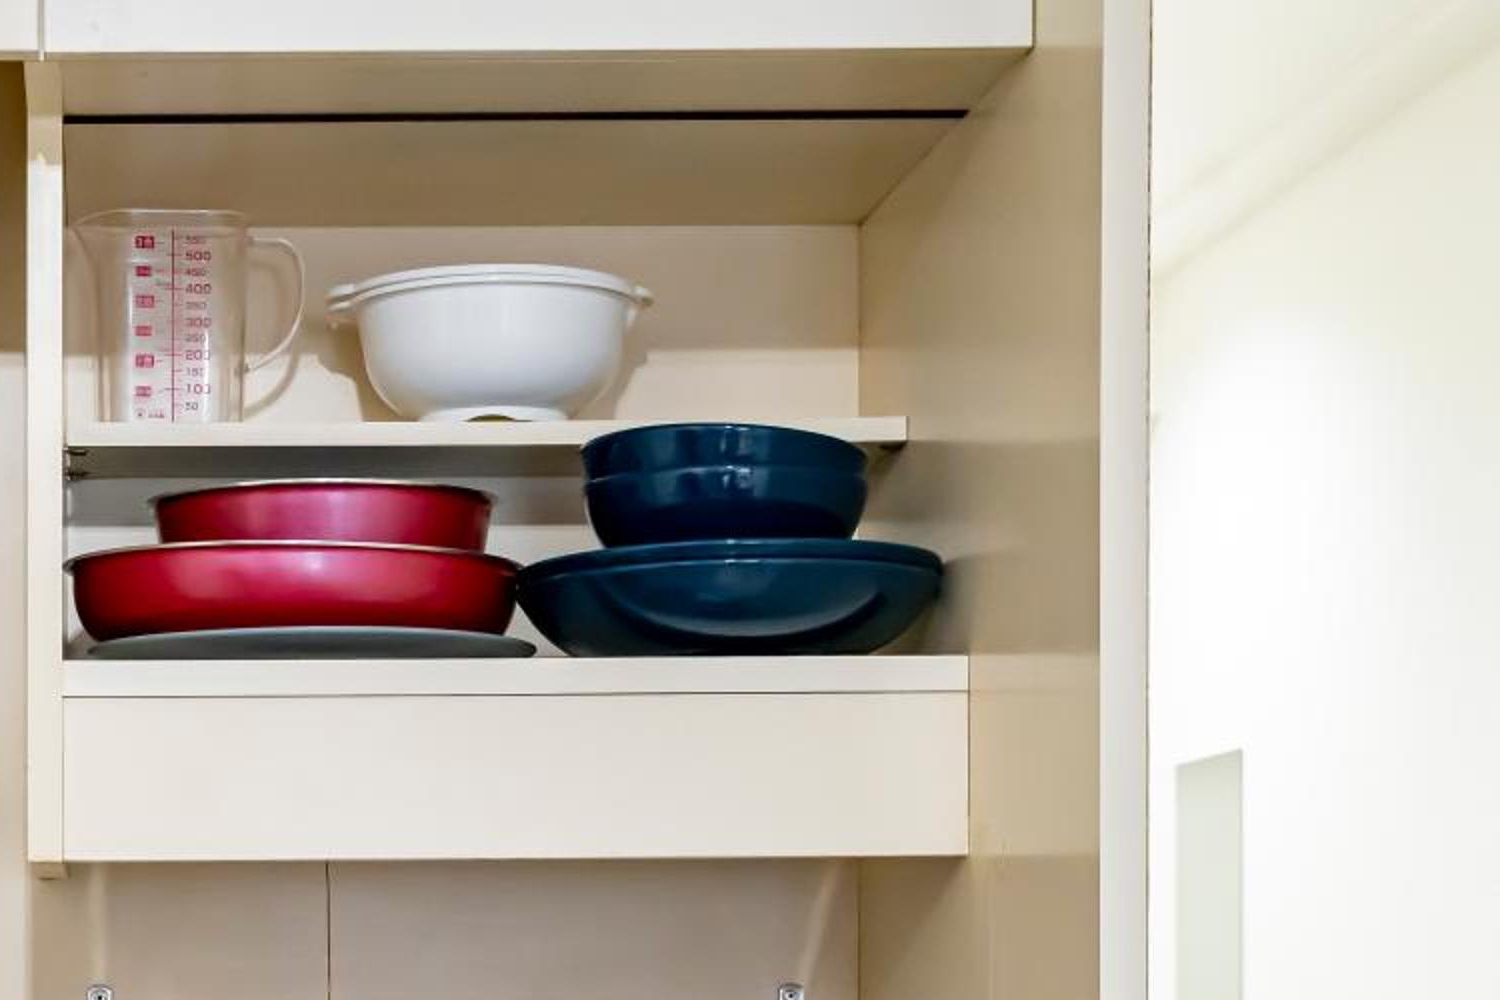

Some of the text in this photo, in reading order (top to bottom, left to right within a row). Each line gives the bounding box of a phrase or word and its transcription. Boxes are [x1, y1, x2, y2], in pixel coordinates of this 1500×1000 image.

[185, 251, 212, 261] 500
[185, 283, 212, 294] 400
[185, 317, 212, 328] 300
